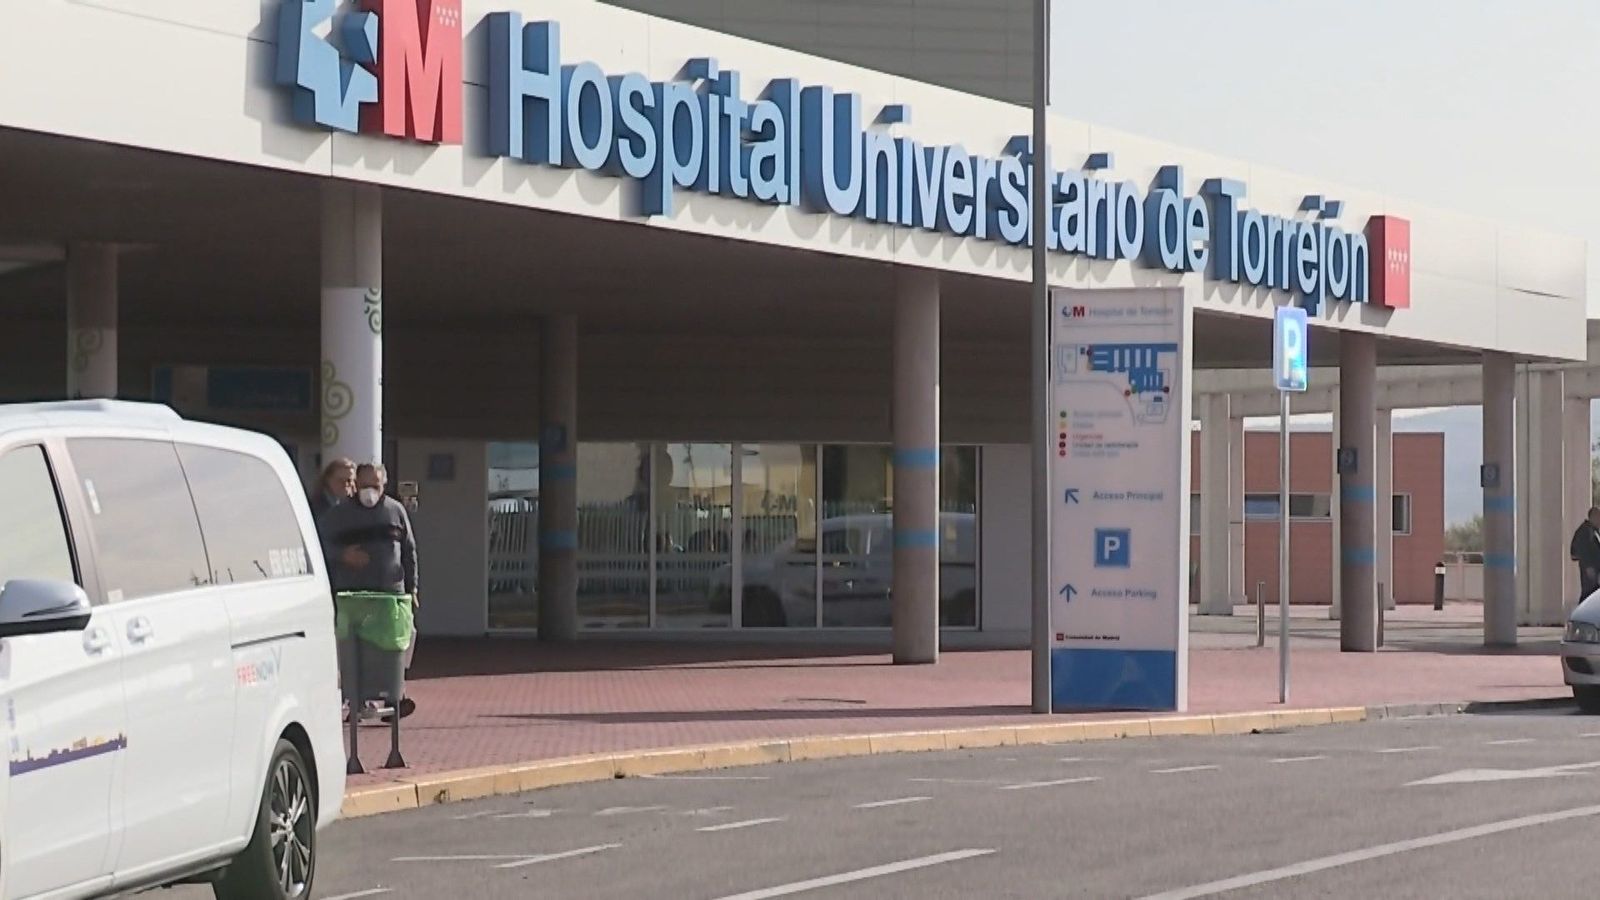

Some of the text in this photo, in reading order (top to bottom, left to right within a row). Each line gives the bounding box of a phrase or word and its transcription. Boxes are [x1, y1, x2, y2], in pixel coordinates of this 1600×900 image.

[383, 0, 1369, 318] M Hospital Universitario de Torrejón
[1072, 306, 1085, 317] M
[1283, 316, 1301, 380] P
[1093, 491, 1163, 502] Acceso Principal
[1104, 536, 1121, 560] P
[1091, 588, 1157, 599] Acceso Parking
